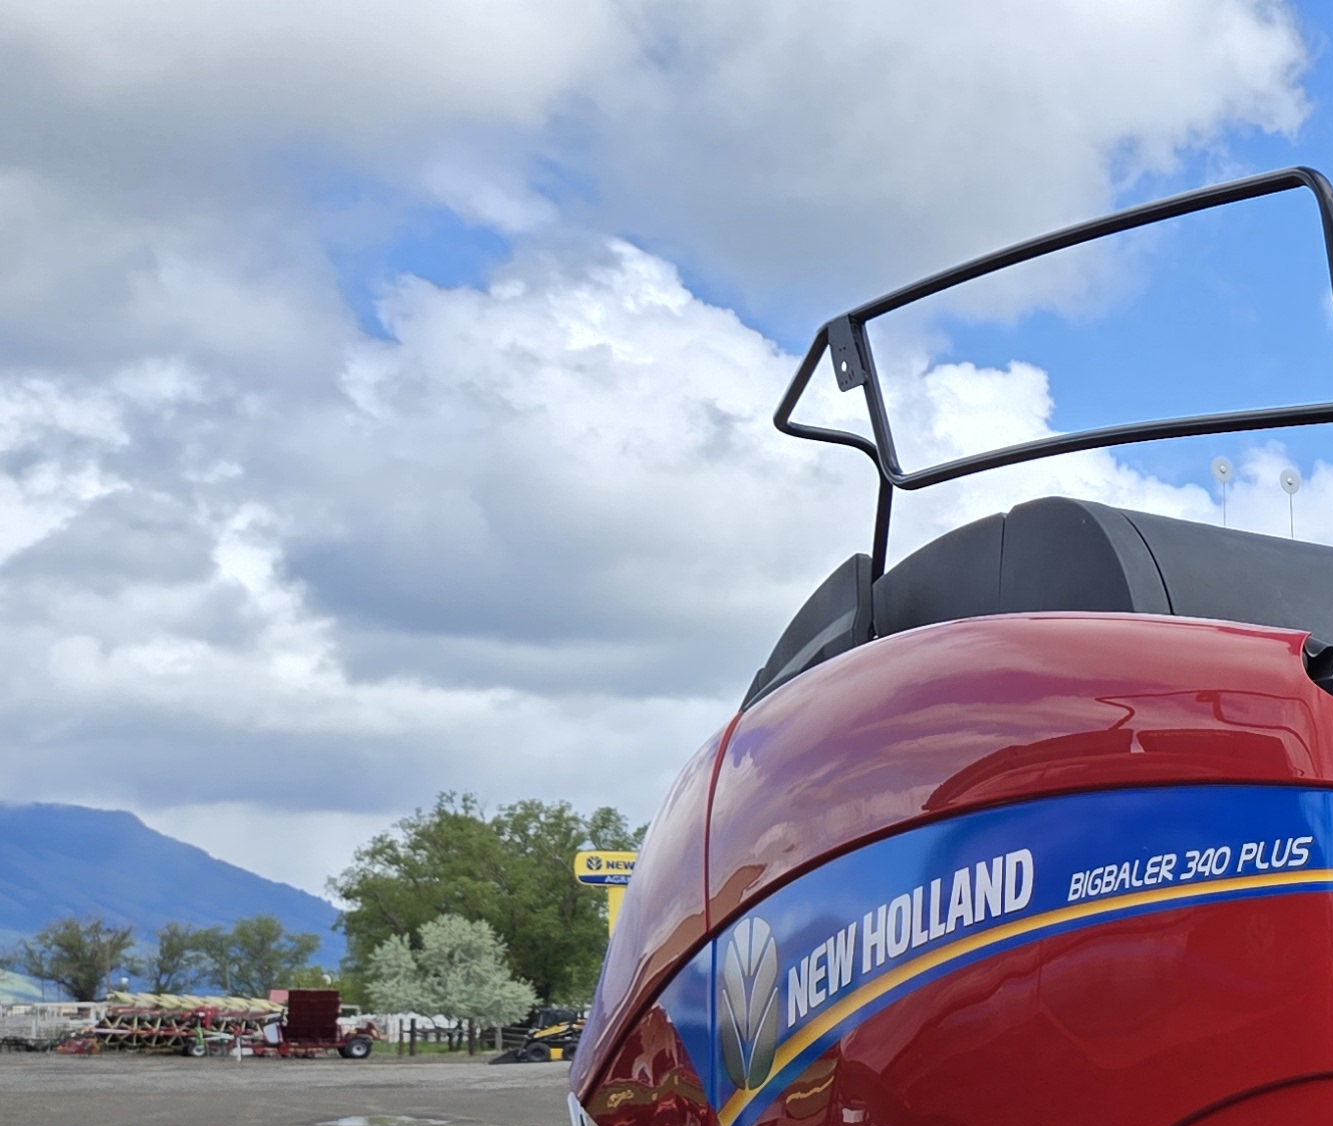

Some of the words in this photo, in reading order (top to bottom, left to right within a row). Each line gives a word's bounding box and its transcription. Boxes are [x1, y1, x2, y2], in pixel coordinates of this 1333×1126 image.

[606, 860, 635, 870] NEW
[1067, 853, 1177, 902] BIGBALER
[1180, 846, 1232, 880] 340
[1236, 836, 1313, 873] PLUS
[787, 921, 857, 1028] NEW
[861, 848, 1034, 975] HOLLAND
